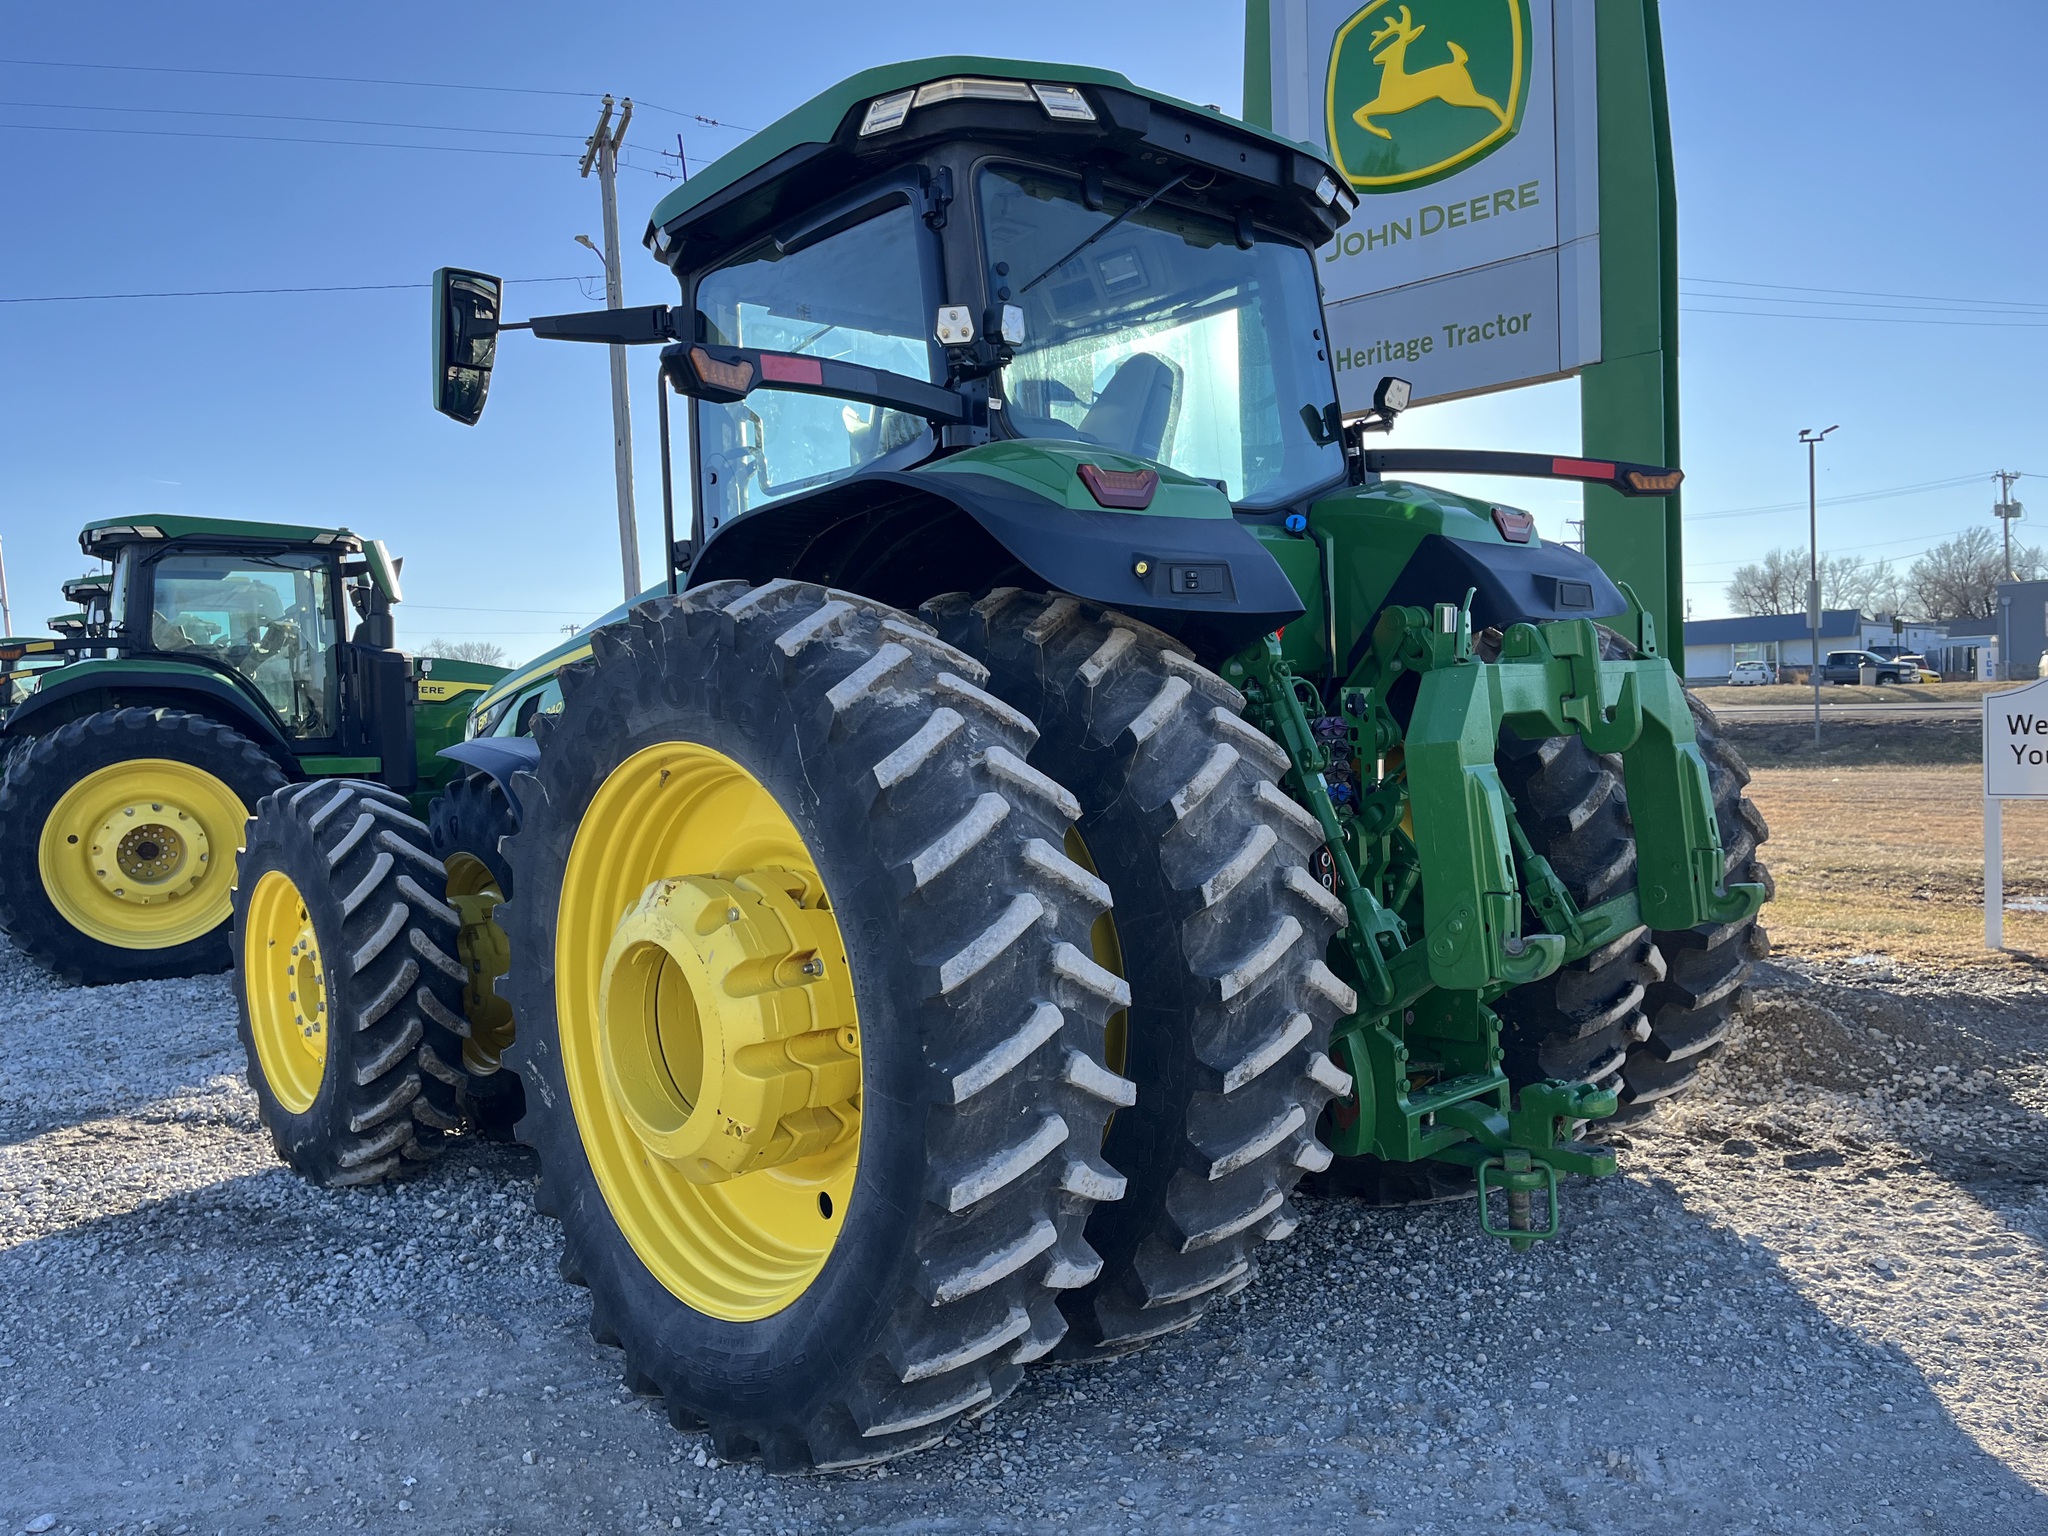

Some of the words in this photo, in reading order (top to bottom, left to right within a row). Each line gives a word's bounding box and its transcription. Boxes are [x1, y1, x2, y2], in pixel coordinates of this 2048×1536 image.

[1325, 217, 1412, 263] JOHN
[1419, 180, 1540, 237] DEERE
[1336, 334, 1434, 372] Heritage
[1442, 313, 1533, 349] Tractor
[418, 686, 445, 695] ERE
[2006, 714, 2048, 735] We
[2010, 744, 2048, 765] Yo
